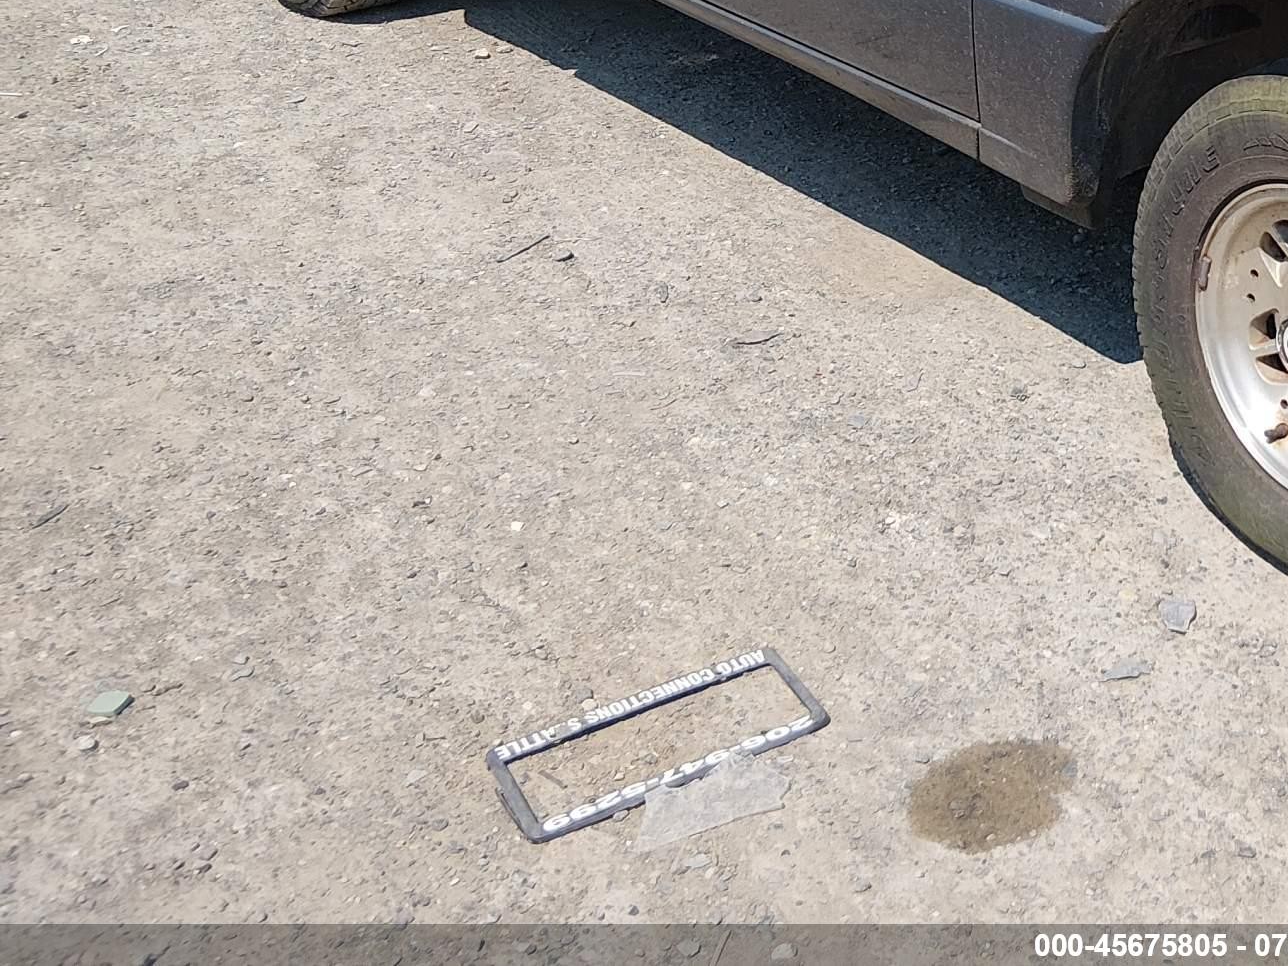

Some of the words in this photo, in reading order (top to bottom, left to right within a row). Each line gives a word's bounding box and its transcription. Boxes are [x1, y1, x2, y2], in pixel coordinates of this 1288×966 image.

[716, 649, 766, 675] AUTO
[584, 668, 716, 724] CONNECTIONS
[496, 717, 582, 760] SATTLE
[541, 714, 814, 832] 206-947-5299
